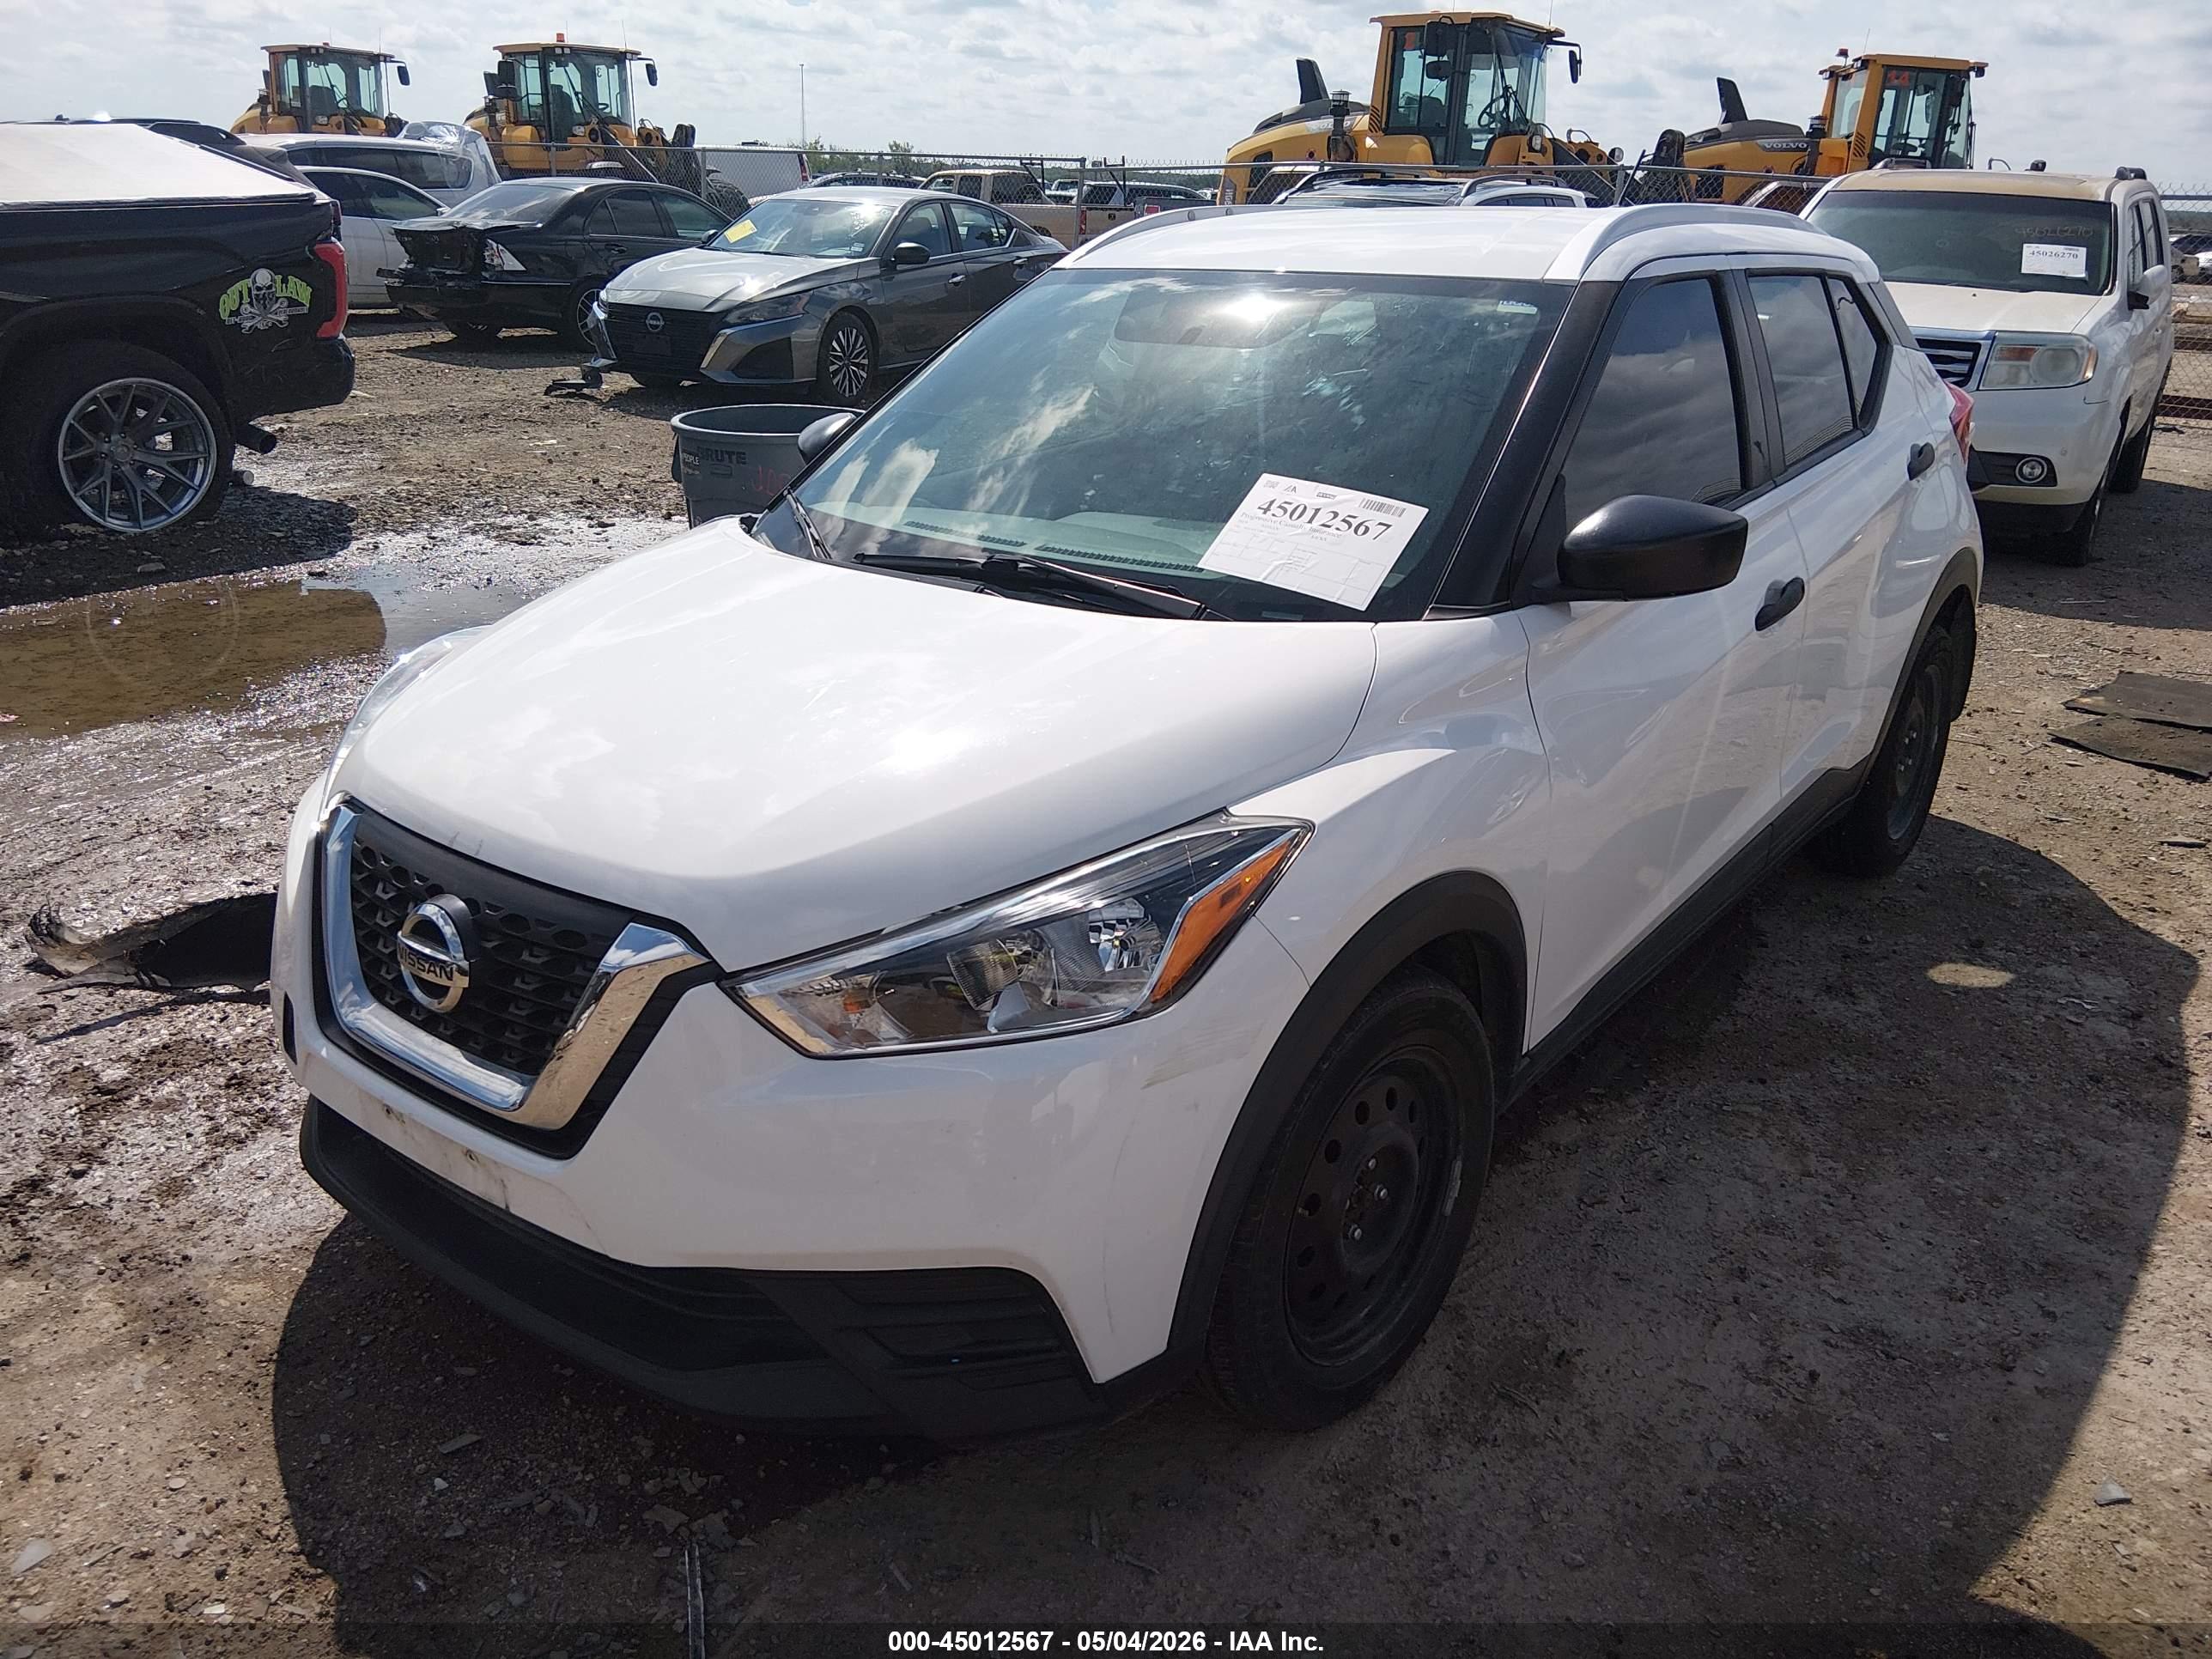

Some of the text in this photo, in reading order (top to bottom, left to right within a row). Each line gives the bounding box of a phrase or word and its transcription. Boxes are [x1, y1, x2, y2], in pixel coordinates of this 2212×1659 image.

[2029, 250, 2079, 259] 45026270
[1256, 497, 1393, 541] 45012567
[398, 945, 454, 981] NISSAN
